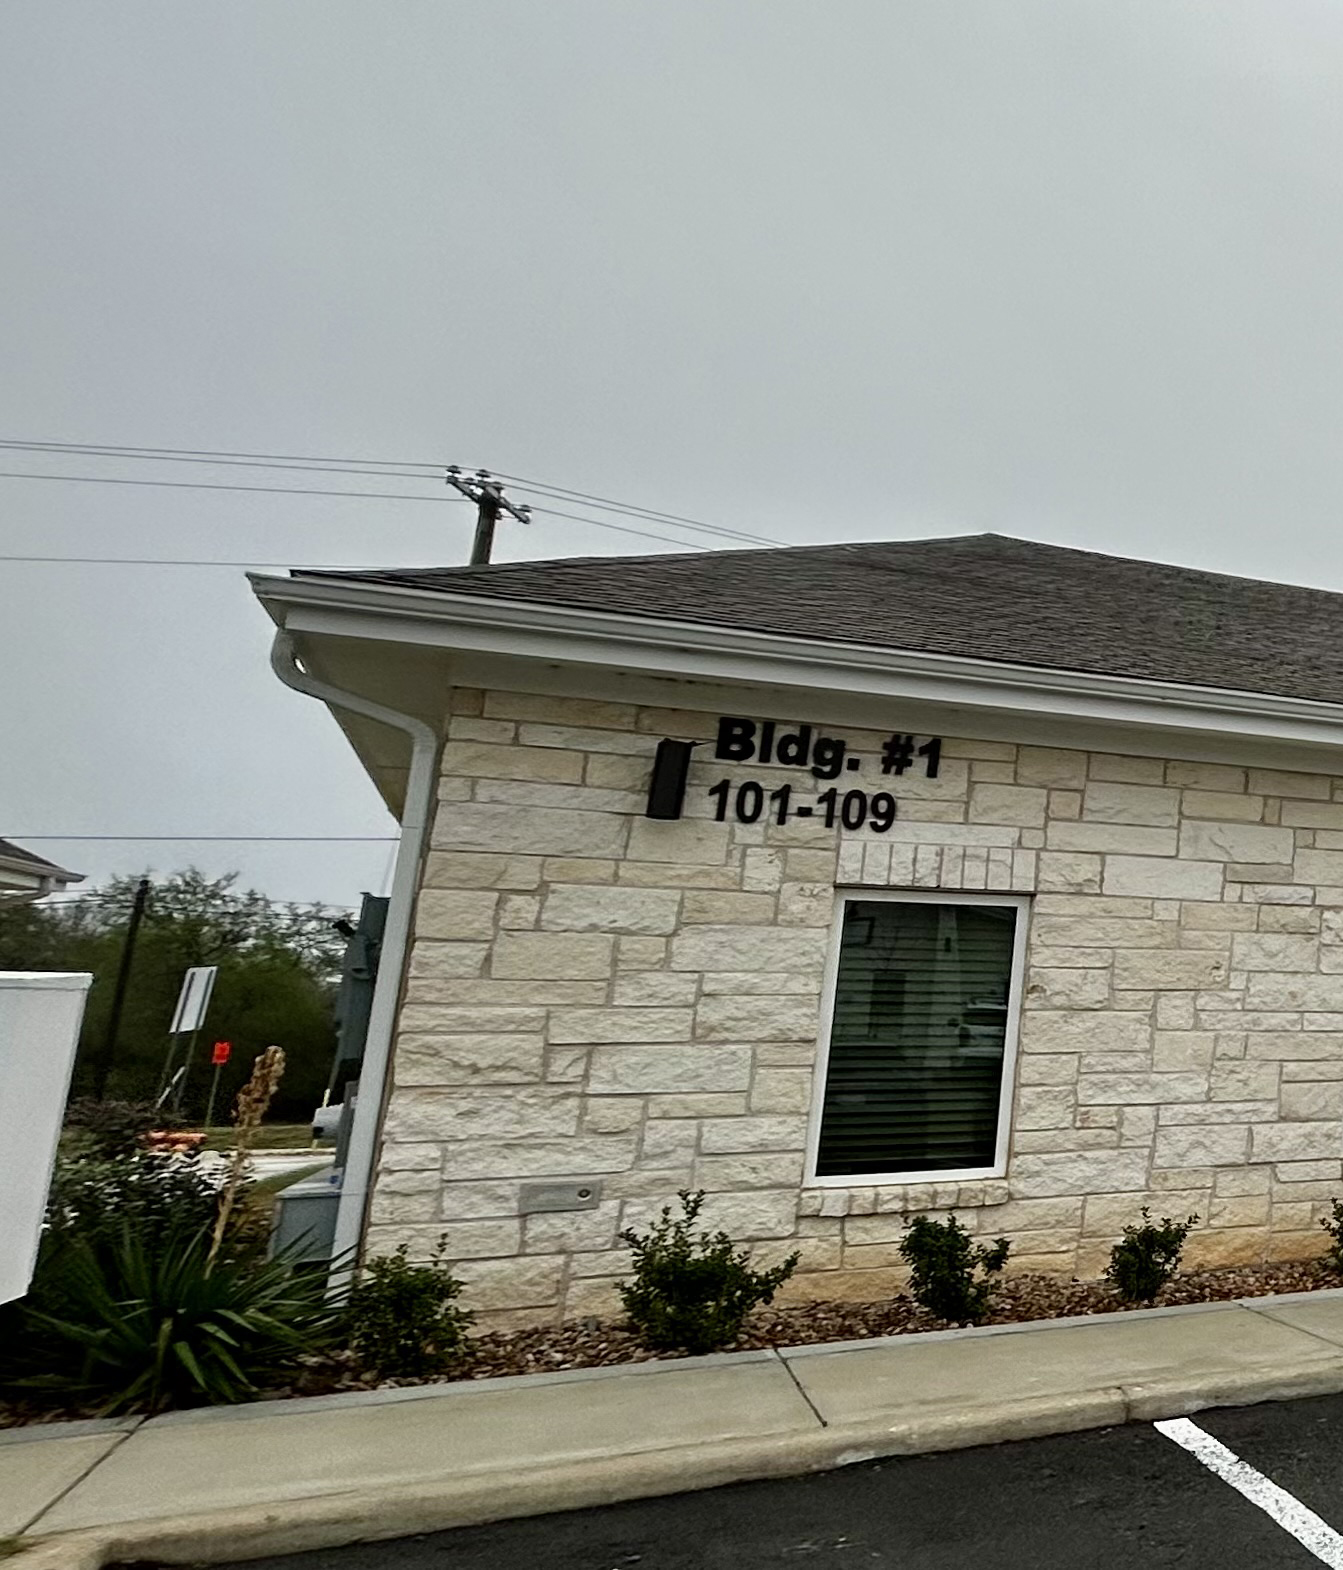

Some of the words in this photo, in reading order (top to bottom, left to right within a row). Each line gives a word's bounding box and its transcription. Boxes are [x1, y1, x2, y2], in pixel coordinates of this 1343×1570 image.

[715, 716, 860, 780] Bldg.
[881, 734, 942, 779] #1
[708, 779, 896, 833] 101-109
